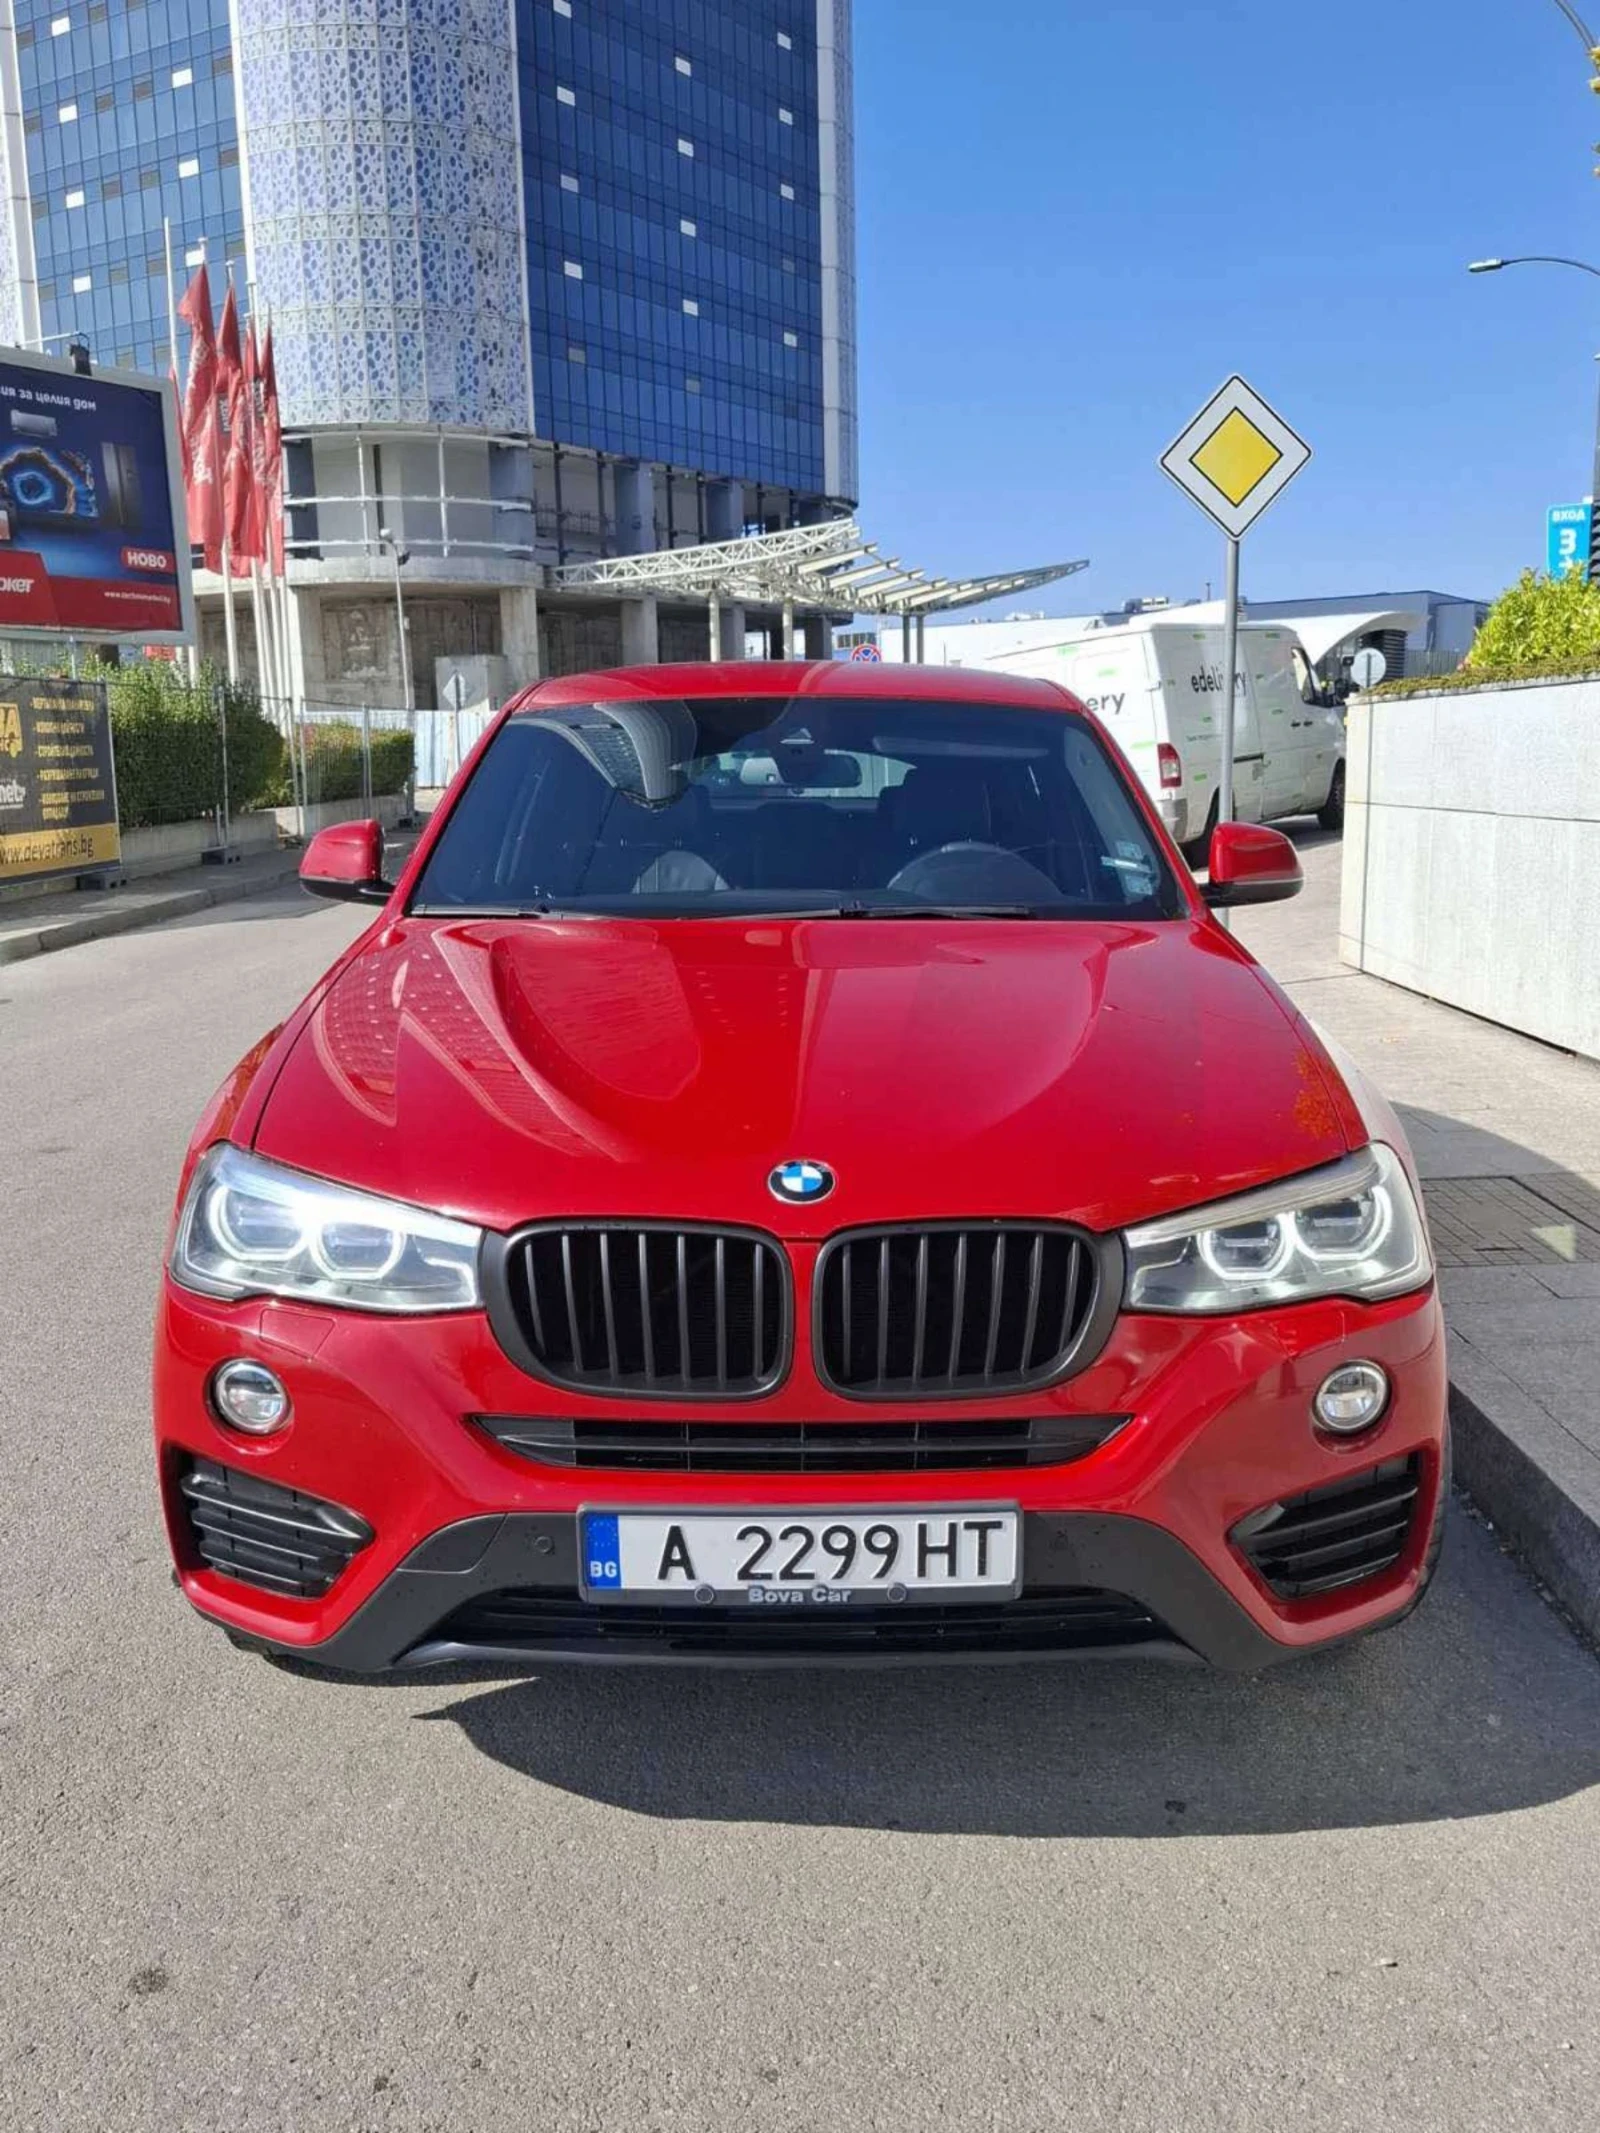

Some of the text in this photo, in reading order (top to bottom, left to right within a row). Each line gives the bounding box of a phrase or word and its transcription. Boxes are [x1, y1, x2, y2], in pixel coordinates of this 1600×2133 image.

[18, 388, 33, 400] за
[73, 398, 96, 411] дом
[1559, 528, 1577, 555] 3
[127, 551, 167, 568] НОВО
[1191, 664, 1247, 697] edeliry
[657, 1524, 696, 1581] A
[735, 1523, 900, 1581] 2299
[589, 1560, 617, 1578] BG
[748, 1586, 852, 1604] Bova Car
